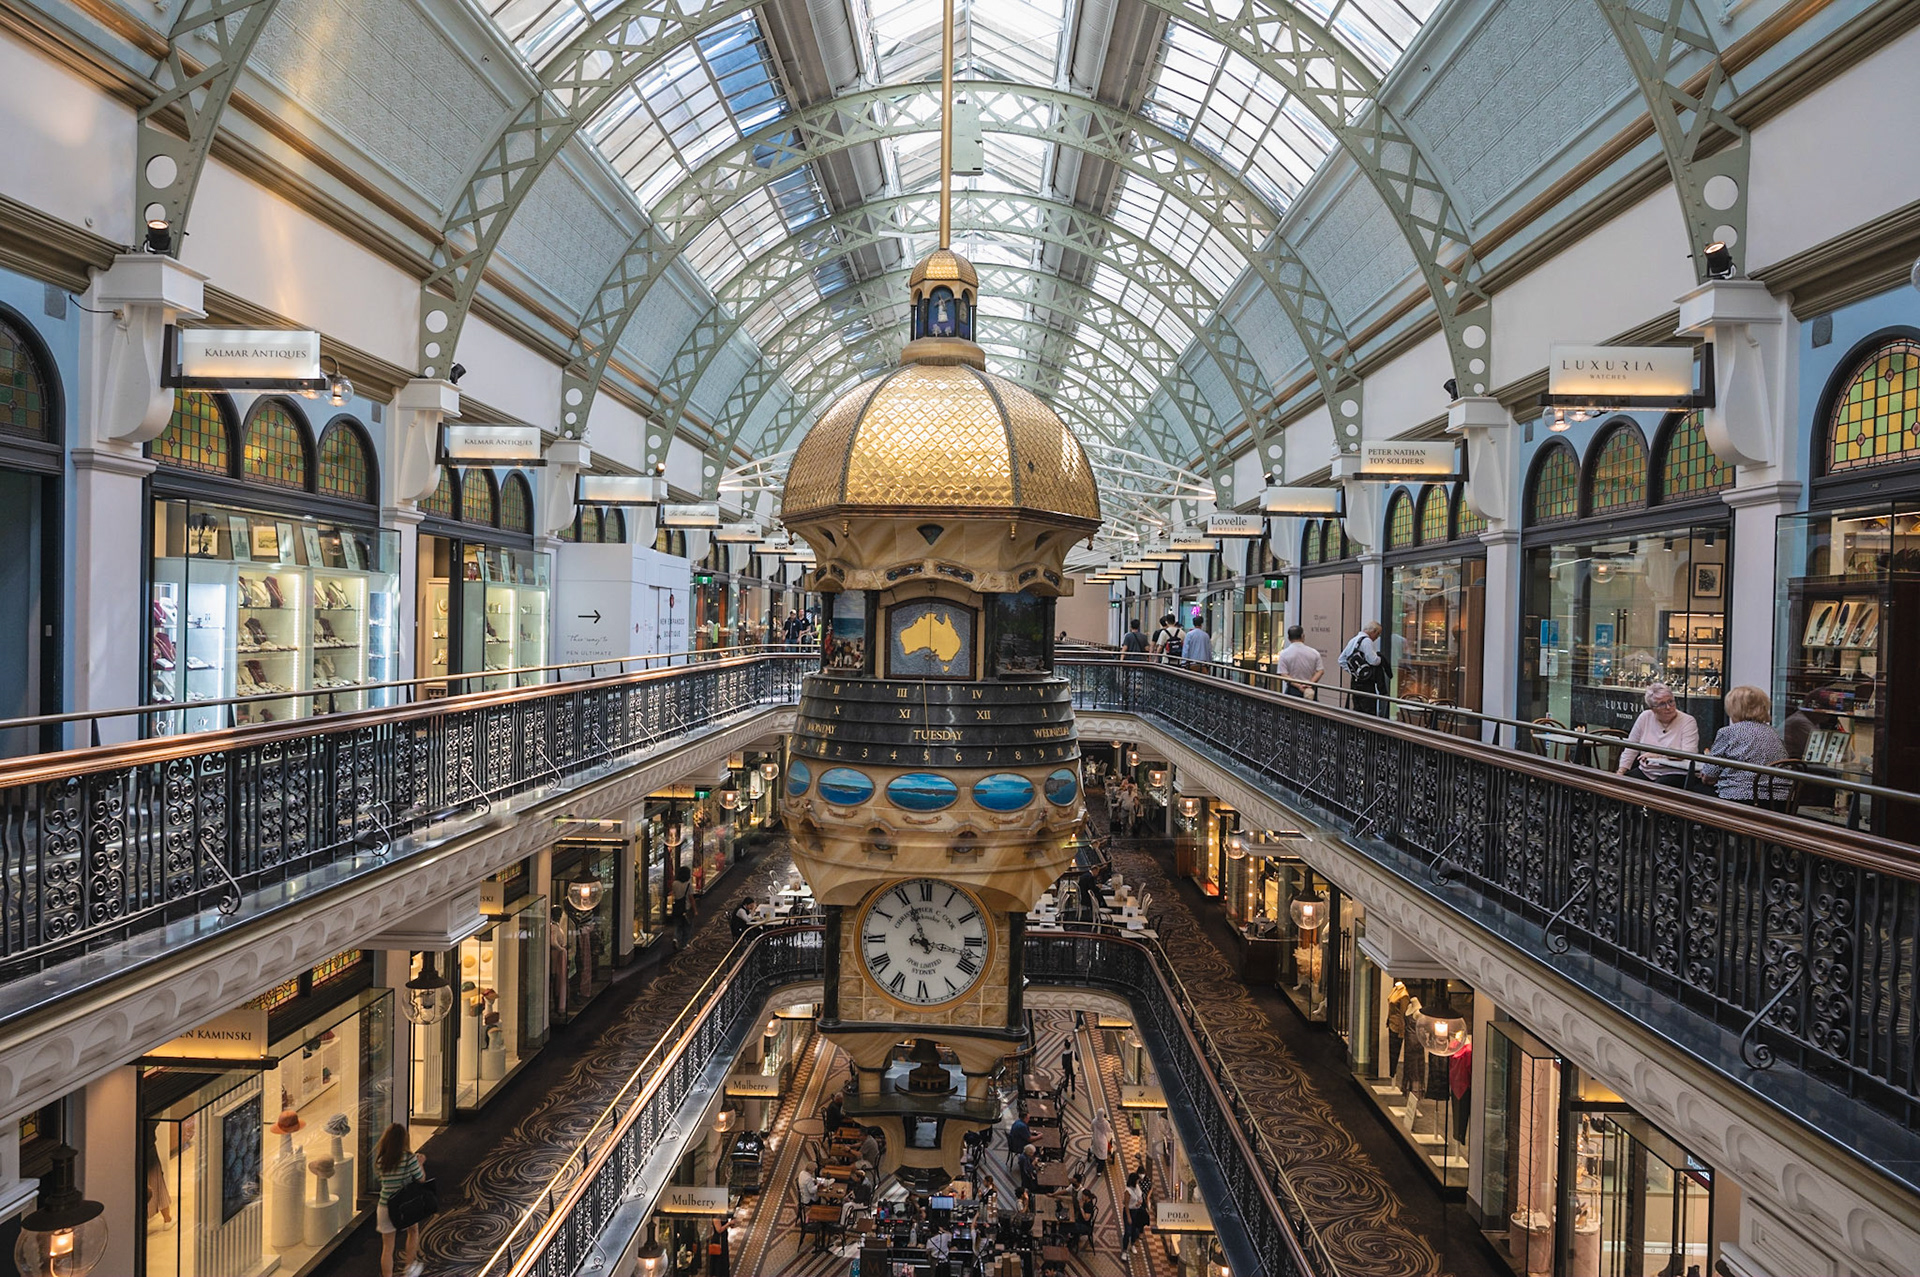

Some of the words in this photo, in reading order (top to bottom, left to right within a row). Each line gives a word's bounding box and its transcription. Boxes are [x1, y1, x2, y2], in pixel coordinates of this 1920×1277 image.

[204, 348, 248, 357] KALMAR
[252, 349, 307, 359] ANTIQUES
[1562, 360, 1653, 371] LUXURIA
[896, 688, 908, 698] III
[972, 690, 982, 699] IV
[1038, 688, 1043, 697] V
[1605, 700, 1644, 712] LUXURIA
[899, 709, 911, 719] XI
[976, 710, 991, 720] XII
[807, 722, 837, 734] MONDAY
[913, 730, 964, 740] TUESDAY
[836, 745, 842, 755] 2
[862, 748, 868, 758] 3
[890, 750, 897, 760] 4
[923, 750, 929, 760] 5
[955, 752, 962, 761] 6
[986, 751, 993, 760] 7
[1015, 751, 1022, 760] 8
[1039, 750, 1044, 758] 9
[920, 884, 933, 902] XII
[942, 914, 956, 930] COOK
[198, 1031, 251, 1040] KAMINSKI
[734, 1080, 769, 1092] Mulberry
[672, 1194, 716, 1209] Mulberry
